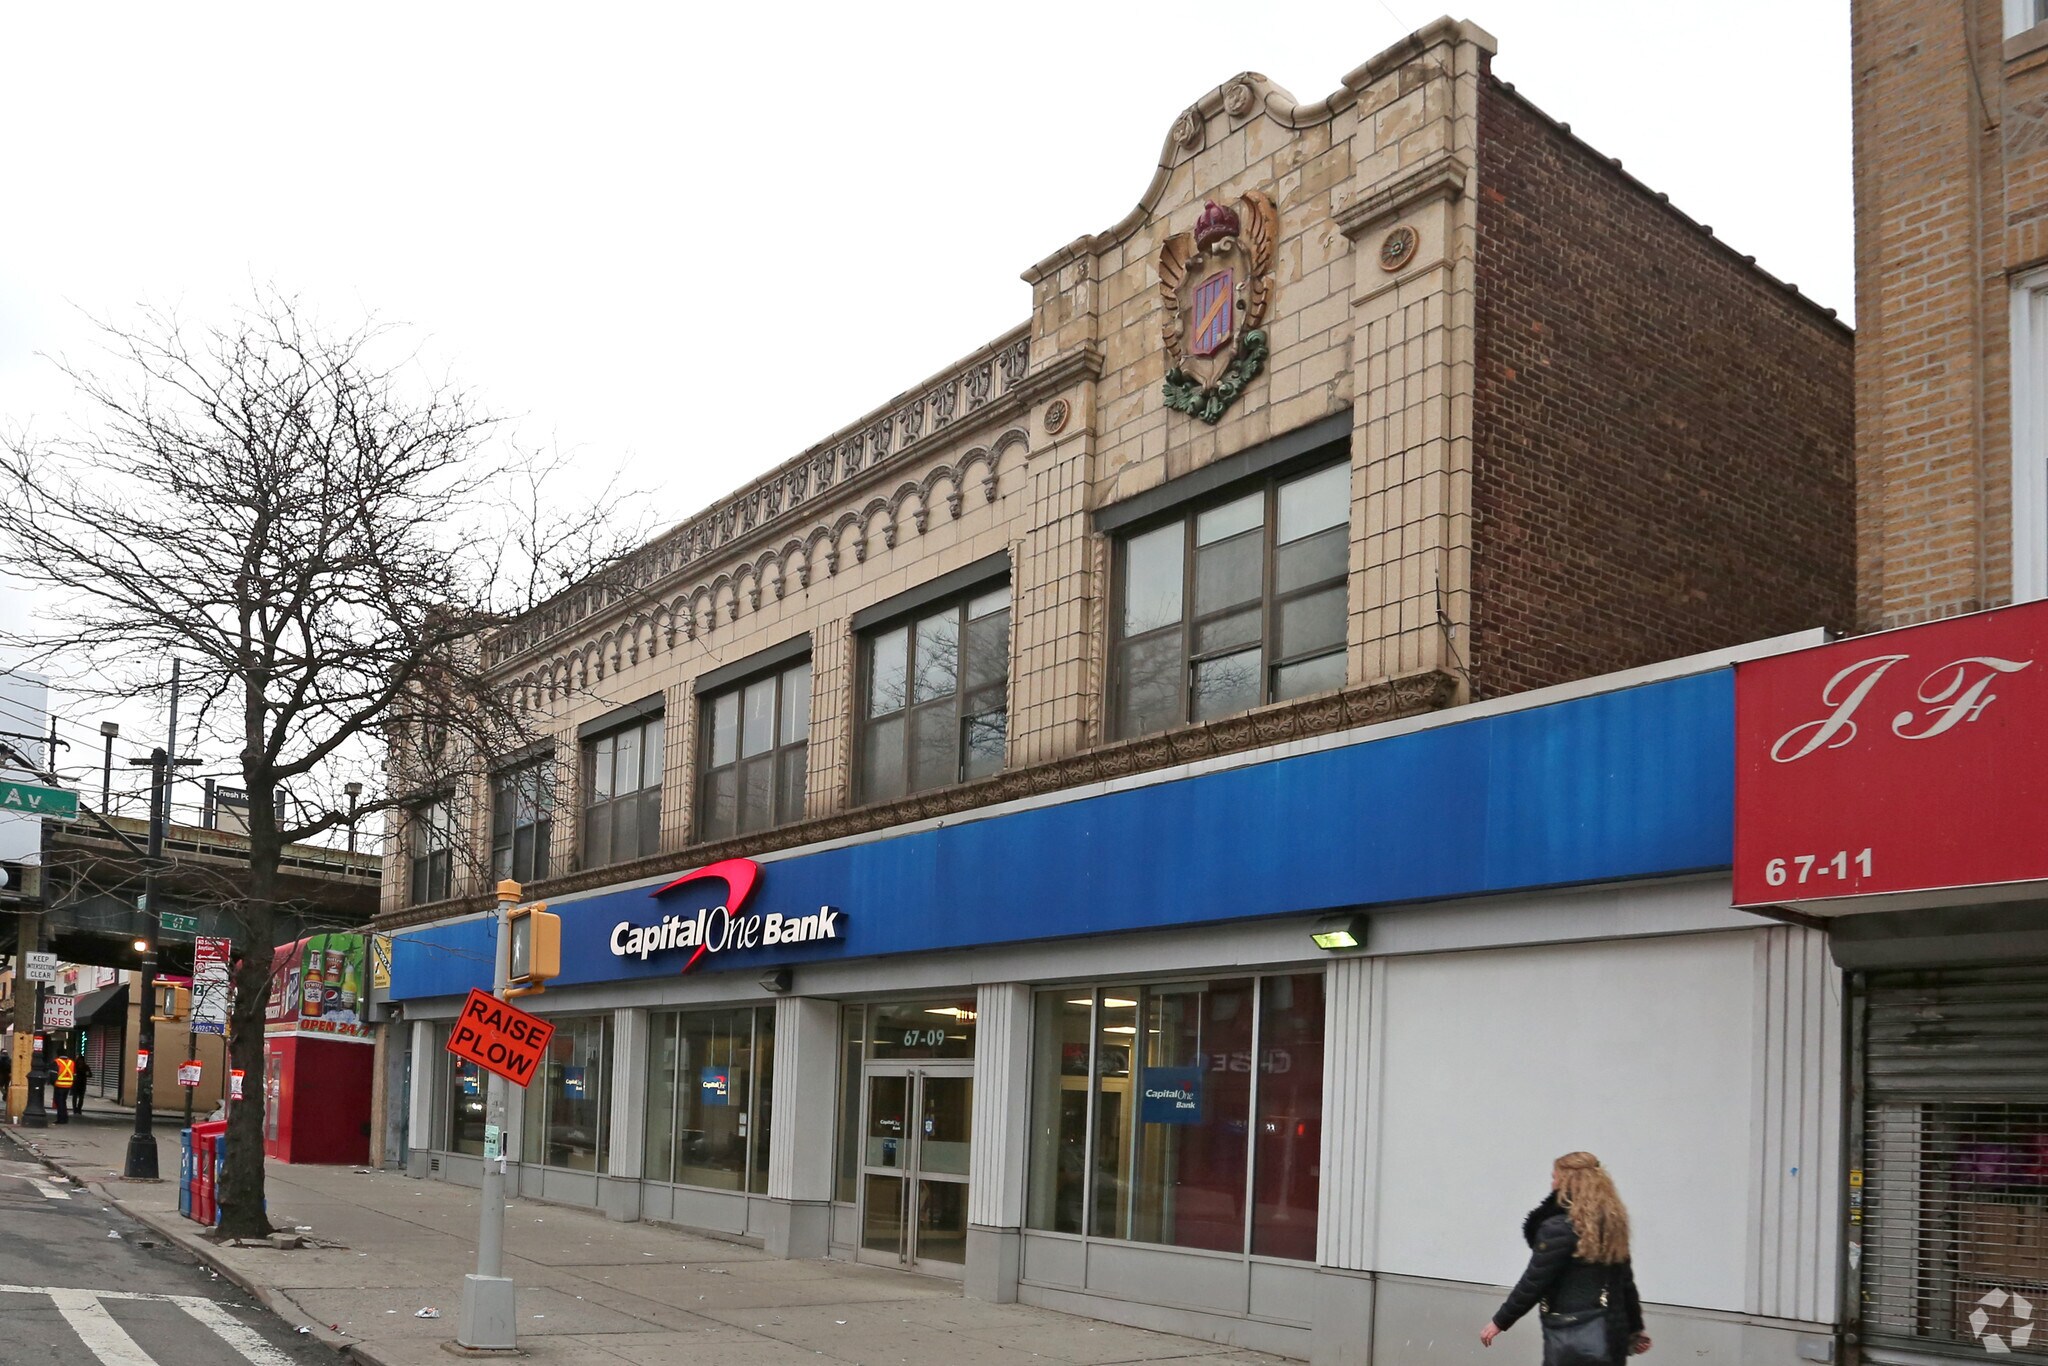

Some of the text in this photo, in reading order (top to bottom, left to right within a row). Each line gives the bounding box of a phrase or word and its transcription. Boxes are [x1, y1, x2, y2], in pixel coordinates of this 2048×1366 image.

[1770, 654, 2034, 763] J F
[4, 788, 43, 808] Av
[218, 789, 249, 801] Fresh Po
[1765, 848, 1872, 886] 67-11
[762, 905, 839, 946] Bank
[33, 955, 50, 963] KEEP
[27, 963, 55, 971] INTERSECTION
[30, 971, 51, 979] CLEAR
[44, 996, 73, 1006] ATCH
[58, 1007, 73, 1016] For
[43, 1017, 72, 1027] USES
[300, 1019, 336, 1032] OPEN
[467, 999, 546, 1050] RAISE
[904, 1030, 945, 1046] 67-09
[455, 1026, 533, 1076] PLOW
[1175, 1101, 1196, 1109] Bank
